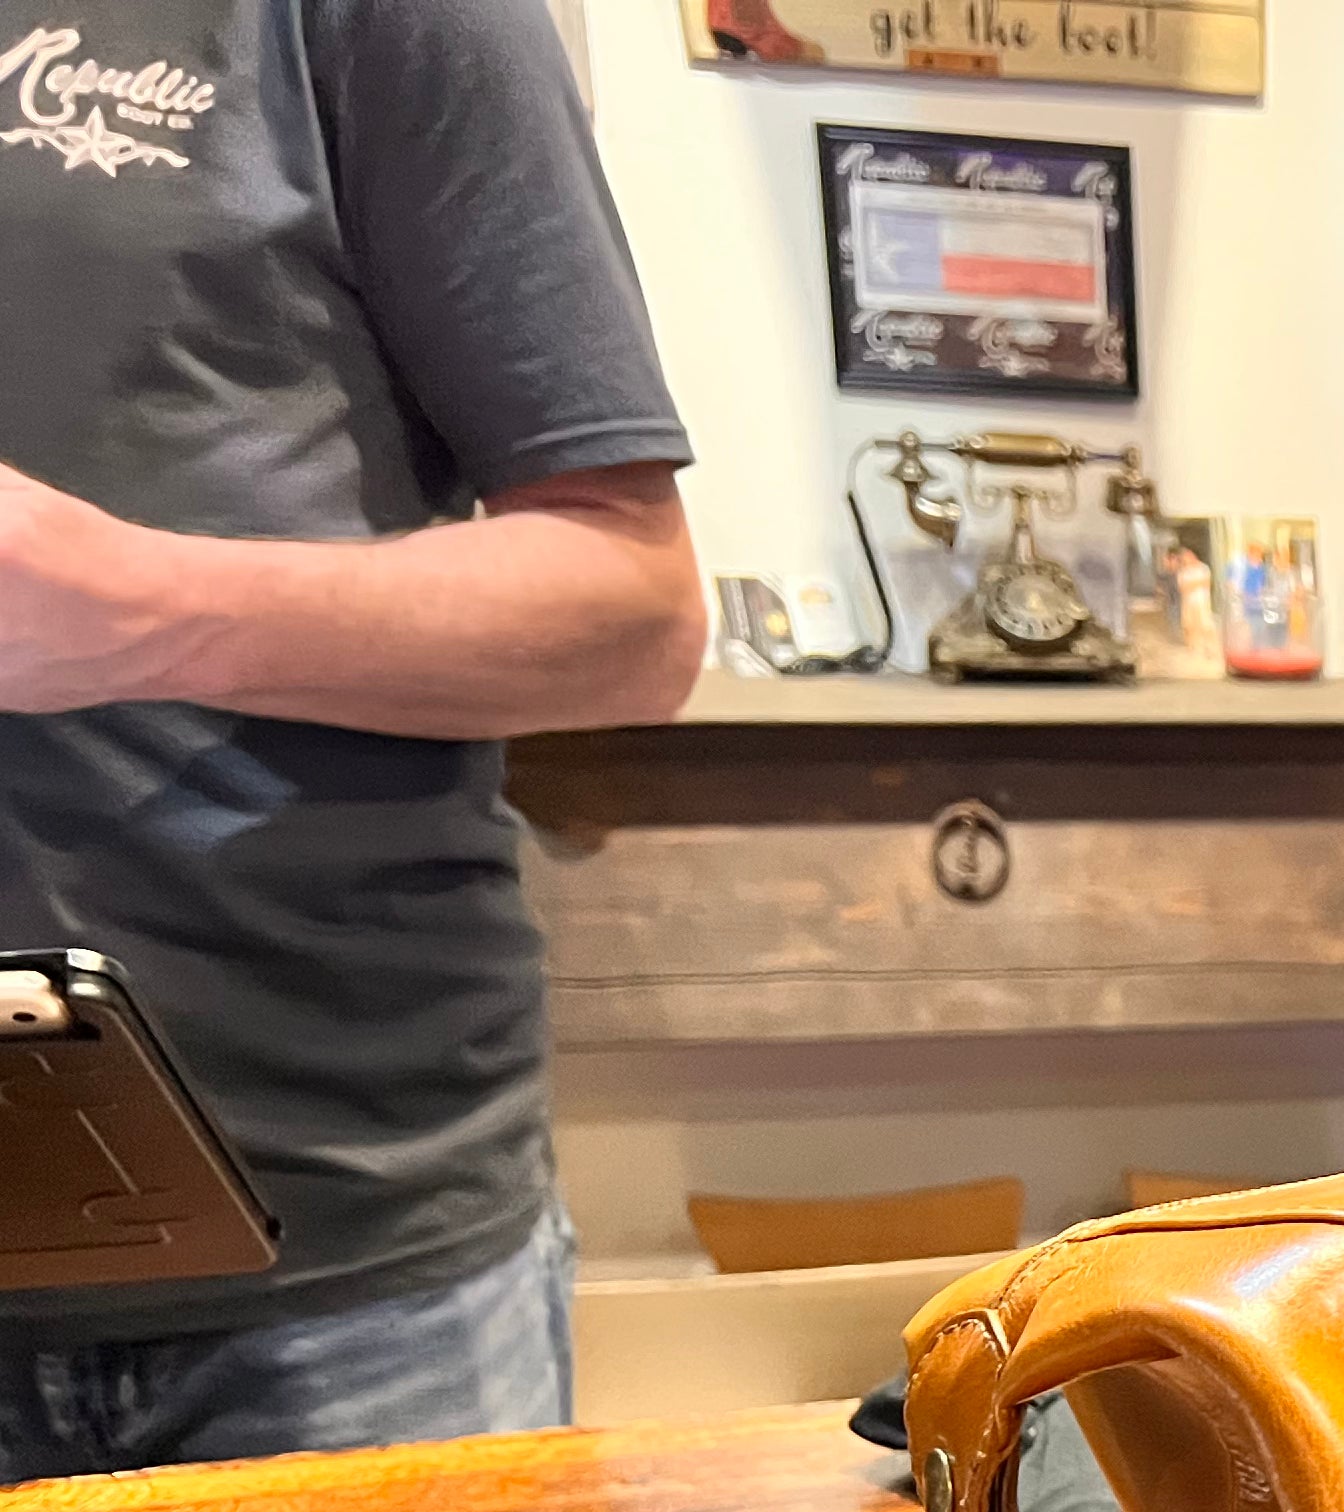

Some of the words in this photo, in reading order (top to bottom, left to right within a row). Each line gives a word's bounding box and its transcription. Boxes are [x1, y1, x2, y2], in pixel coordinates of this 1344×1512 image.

[870, 0, 935, 58] get
[966, 0, 1034, 48] the
[0, 28, 214, 126] Republic
